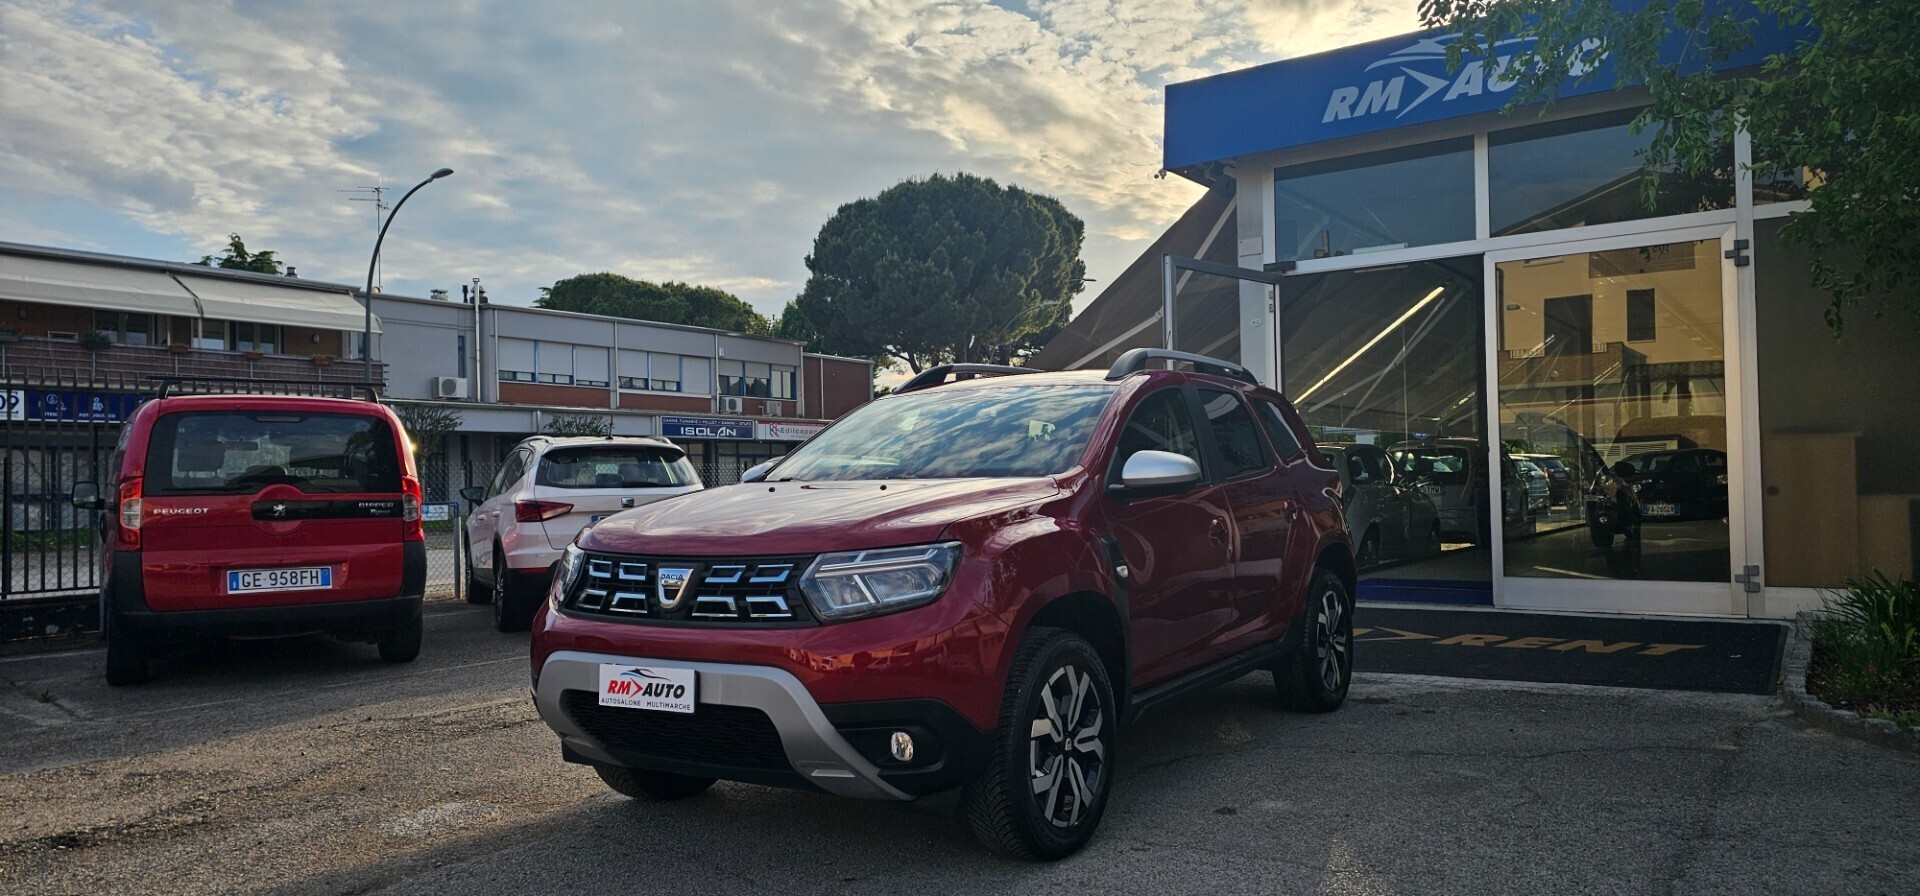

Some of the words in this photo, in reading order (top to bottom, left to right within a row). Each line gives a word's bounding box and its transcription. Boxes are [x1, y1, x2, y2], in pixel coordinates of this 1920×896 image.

[681, 426, 736, 438] ISOLAN
[153, 507, 209, 515] PEUGEOT
[1431, 634, 1706, 656] RENT
[641, 682, 686, 699] AUTO
[601, 697, 640, 707] AUTOSALONE
[646, 701, 691, 711] MULTIMARCHE
